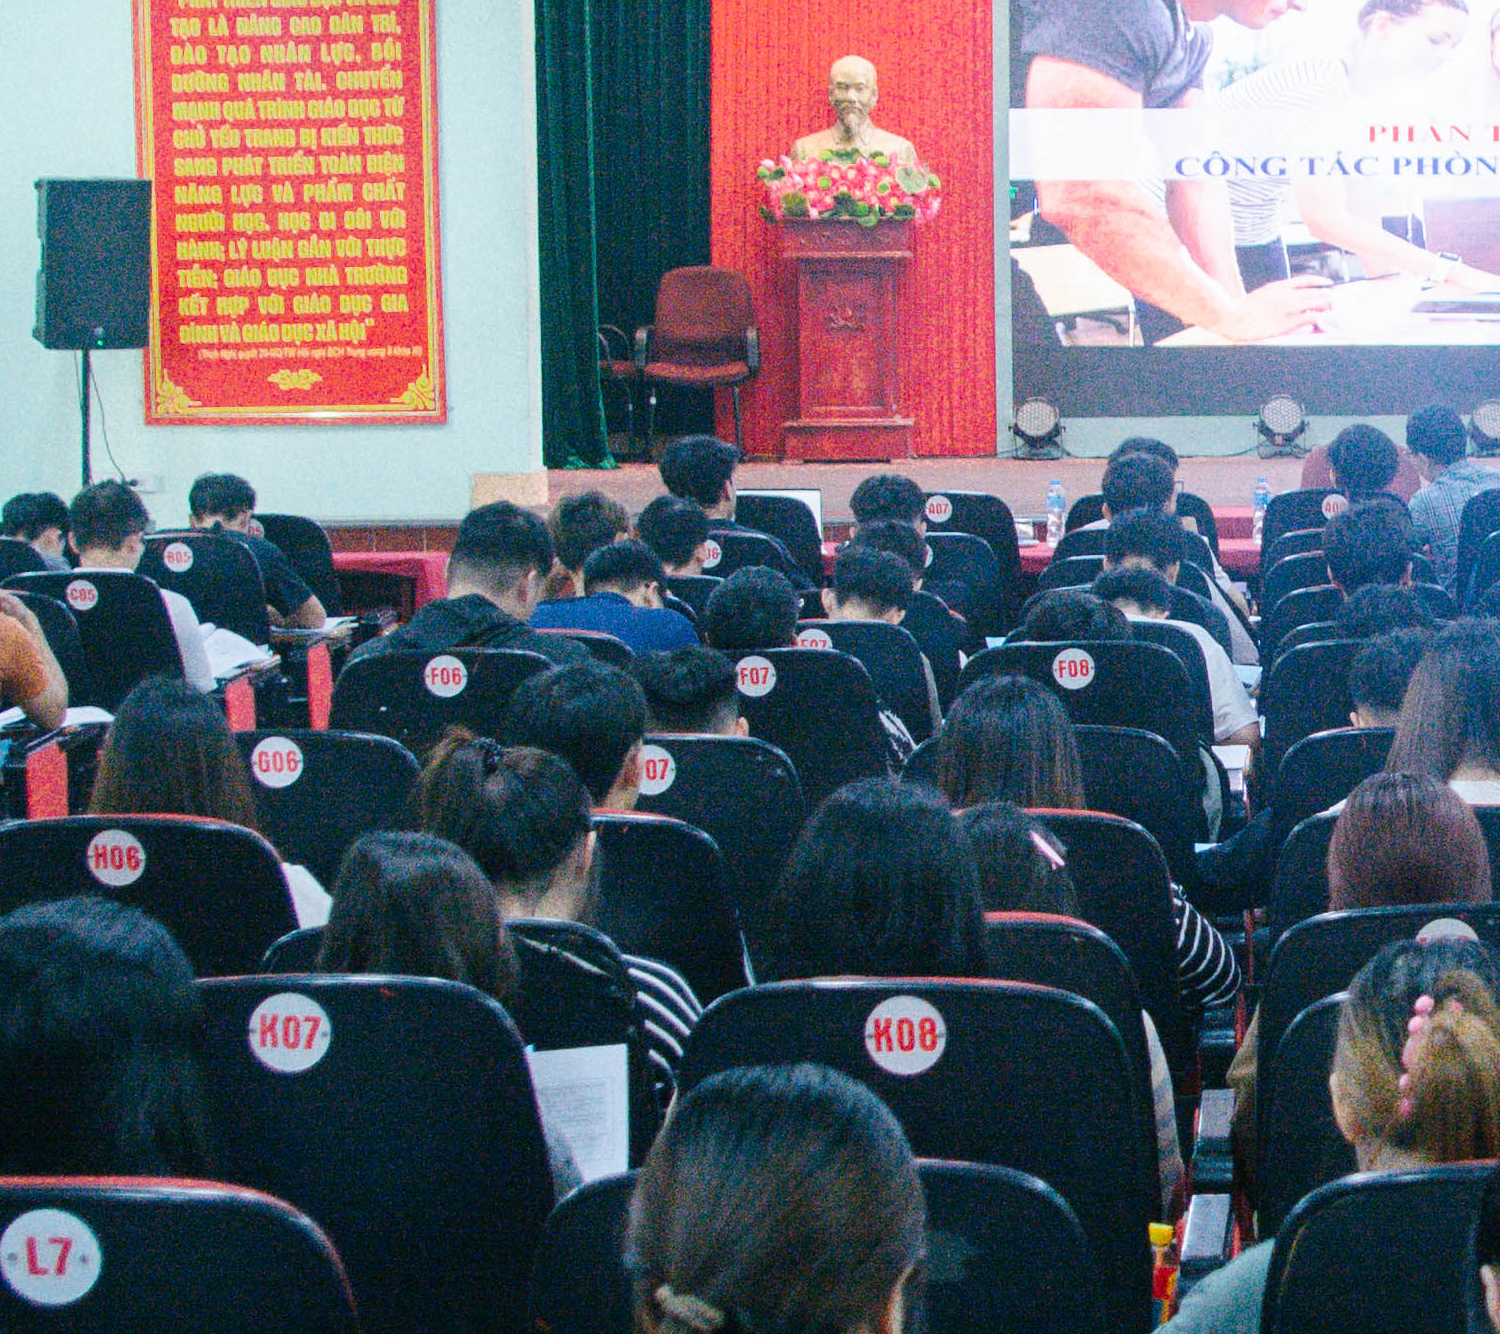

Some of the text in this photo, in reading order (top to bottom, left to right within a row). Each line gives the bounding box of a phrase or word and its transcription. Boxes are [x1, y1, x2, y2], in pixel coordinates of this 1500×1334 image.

[1175, 150, 1288, 177] CÔNG
[1300, 150, 1380, 177] TÁC
[431, 667, 462, 686] F06
[740, 667, 768, 686] F07
[1059, 659, 1089, 677] F08
[257, 751, 299, 773] G06
[645, 759, 669, 780] 07
[93, 845, 140, 870] H06
[259, 1016, 321, 1050] K07
[872, 1018, 939, 1053] K08
[26, 1236, 72, 1276] L7
